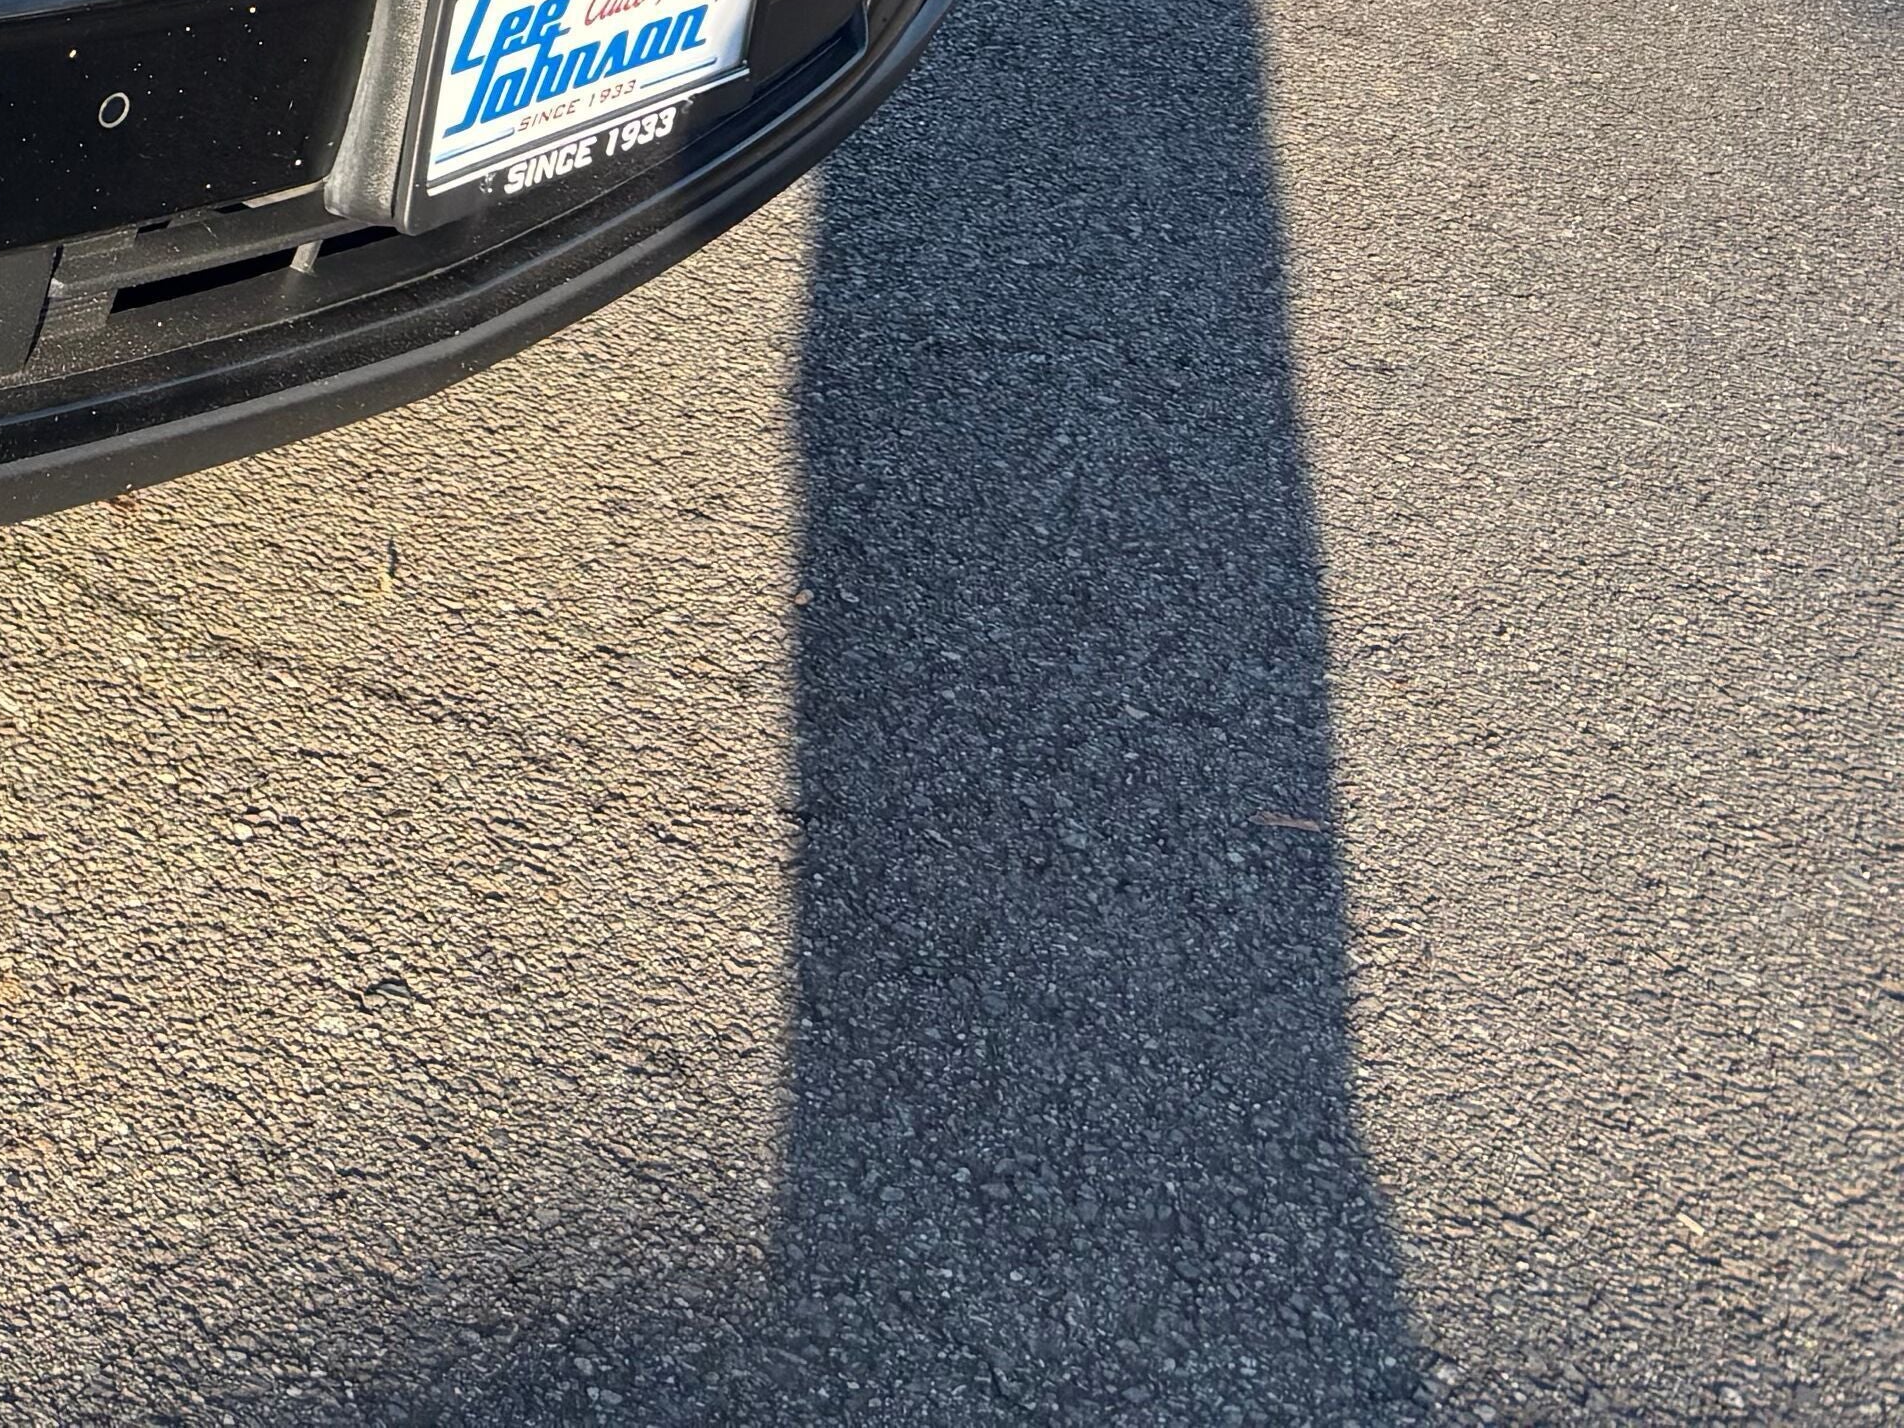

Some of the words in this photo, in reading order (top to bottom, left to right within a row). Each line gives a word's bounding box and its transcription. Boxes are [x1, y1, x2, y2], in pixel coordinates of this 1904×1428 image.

[442, 4, 709, 139] Johnson
[516, 98, 582, 132] SINCE
[589, 79, 637, 108] 1933
[503, 135, 598, 195] SINCE
[605, 106, 677, 157] 1933
